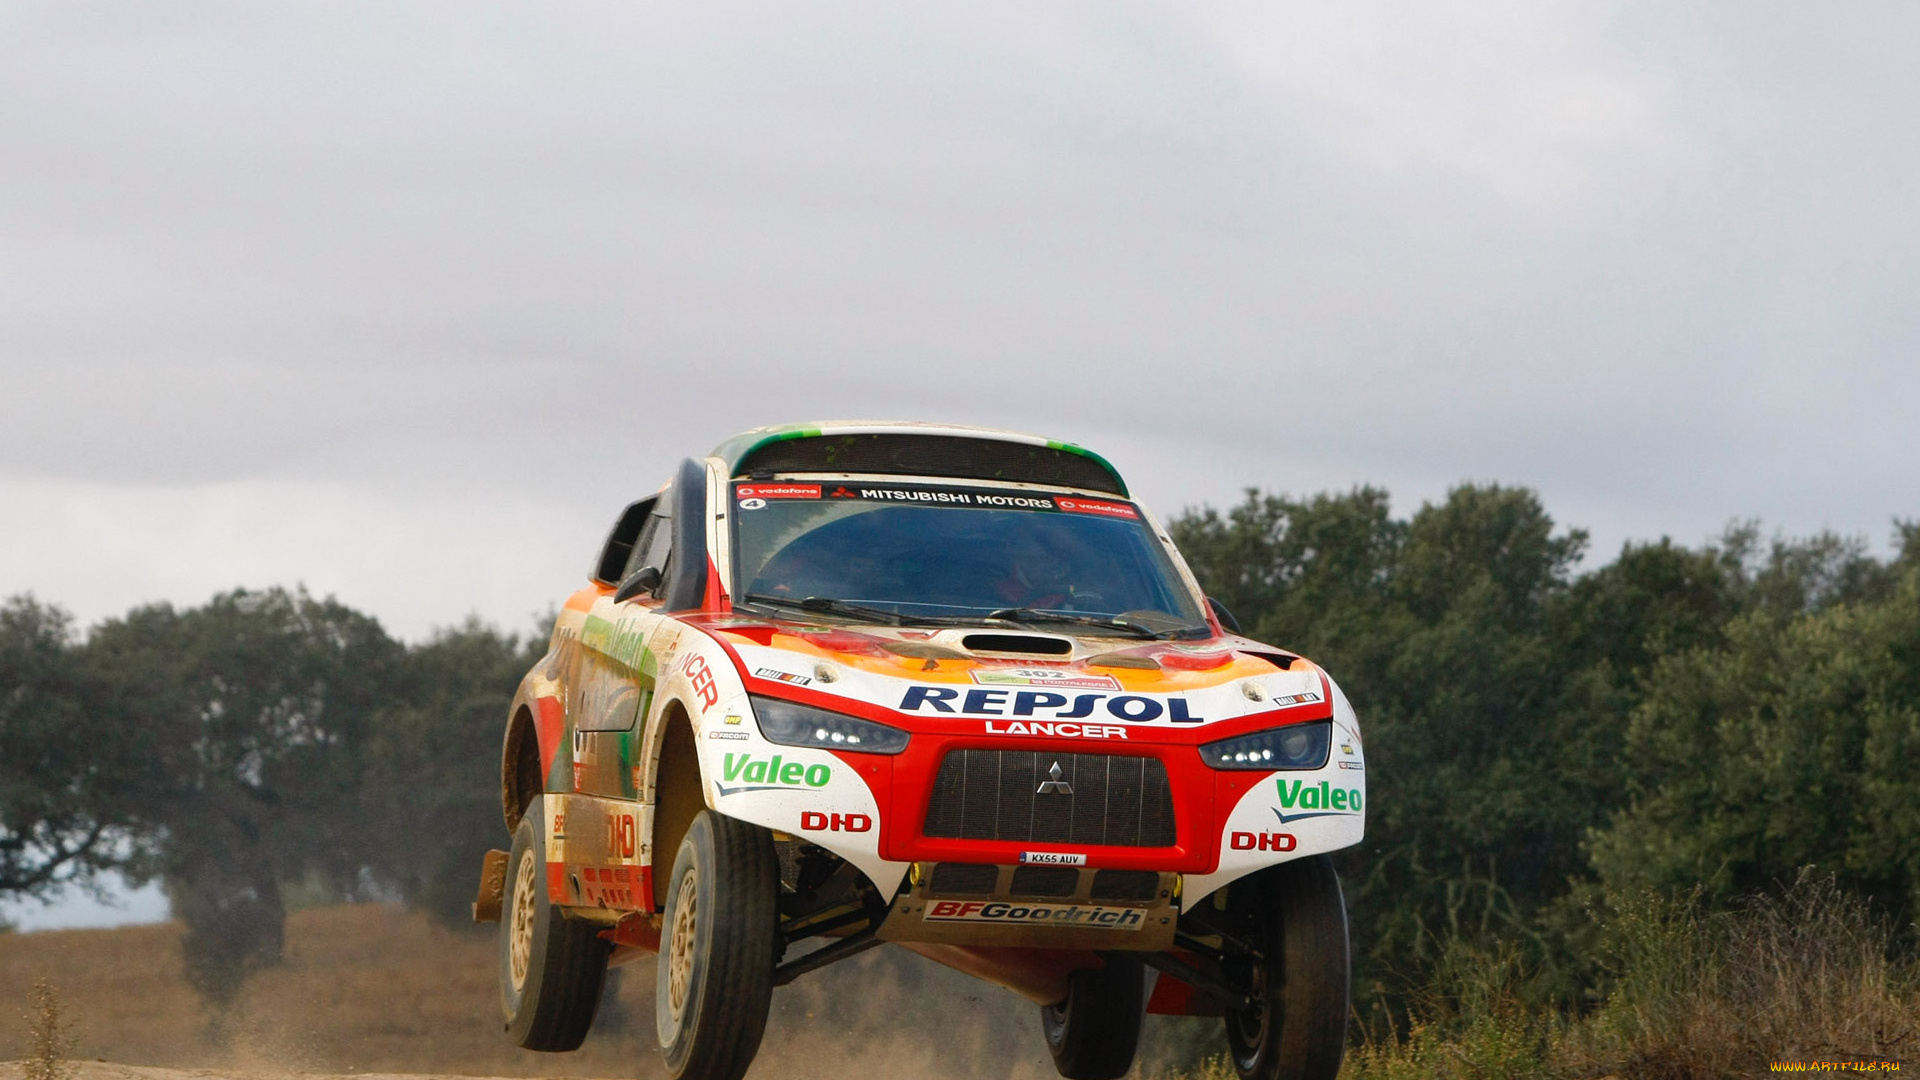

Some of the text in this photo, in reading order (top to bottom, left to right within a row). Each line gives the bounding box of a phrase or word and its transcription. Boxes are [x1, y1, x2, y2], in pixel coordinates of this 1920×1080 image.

[860, 489, 1053, 509] MITSUBISHI MOTORS
[1078, 503, 1134, 516] vodafone
[1016, 669, 1067, 678] 302
[899, 685, 1204, 723] REPSOL
[985, 721, 1128, 740] LANCER
[723, 753, 831, 787] Valeo
[1276, 779, 1362, 812] Valeo
[1032, 854, 1079, 864] KX55 AUV
[930, 901, 1143, 926] BFGoodrich
